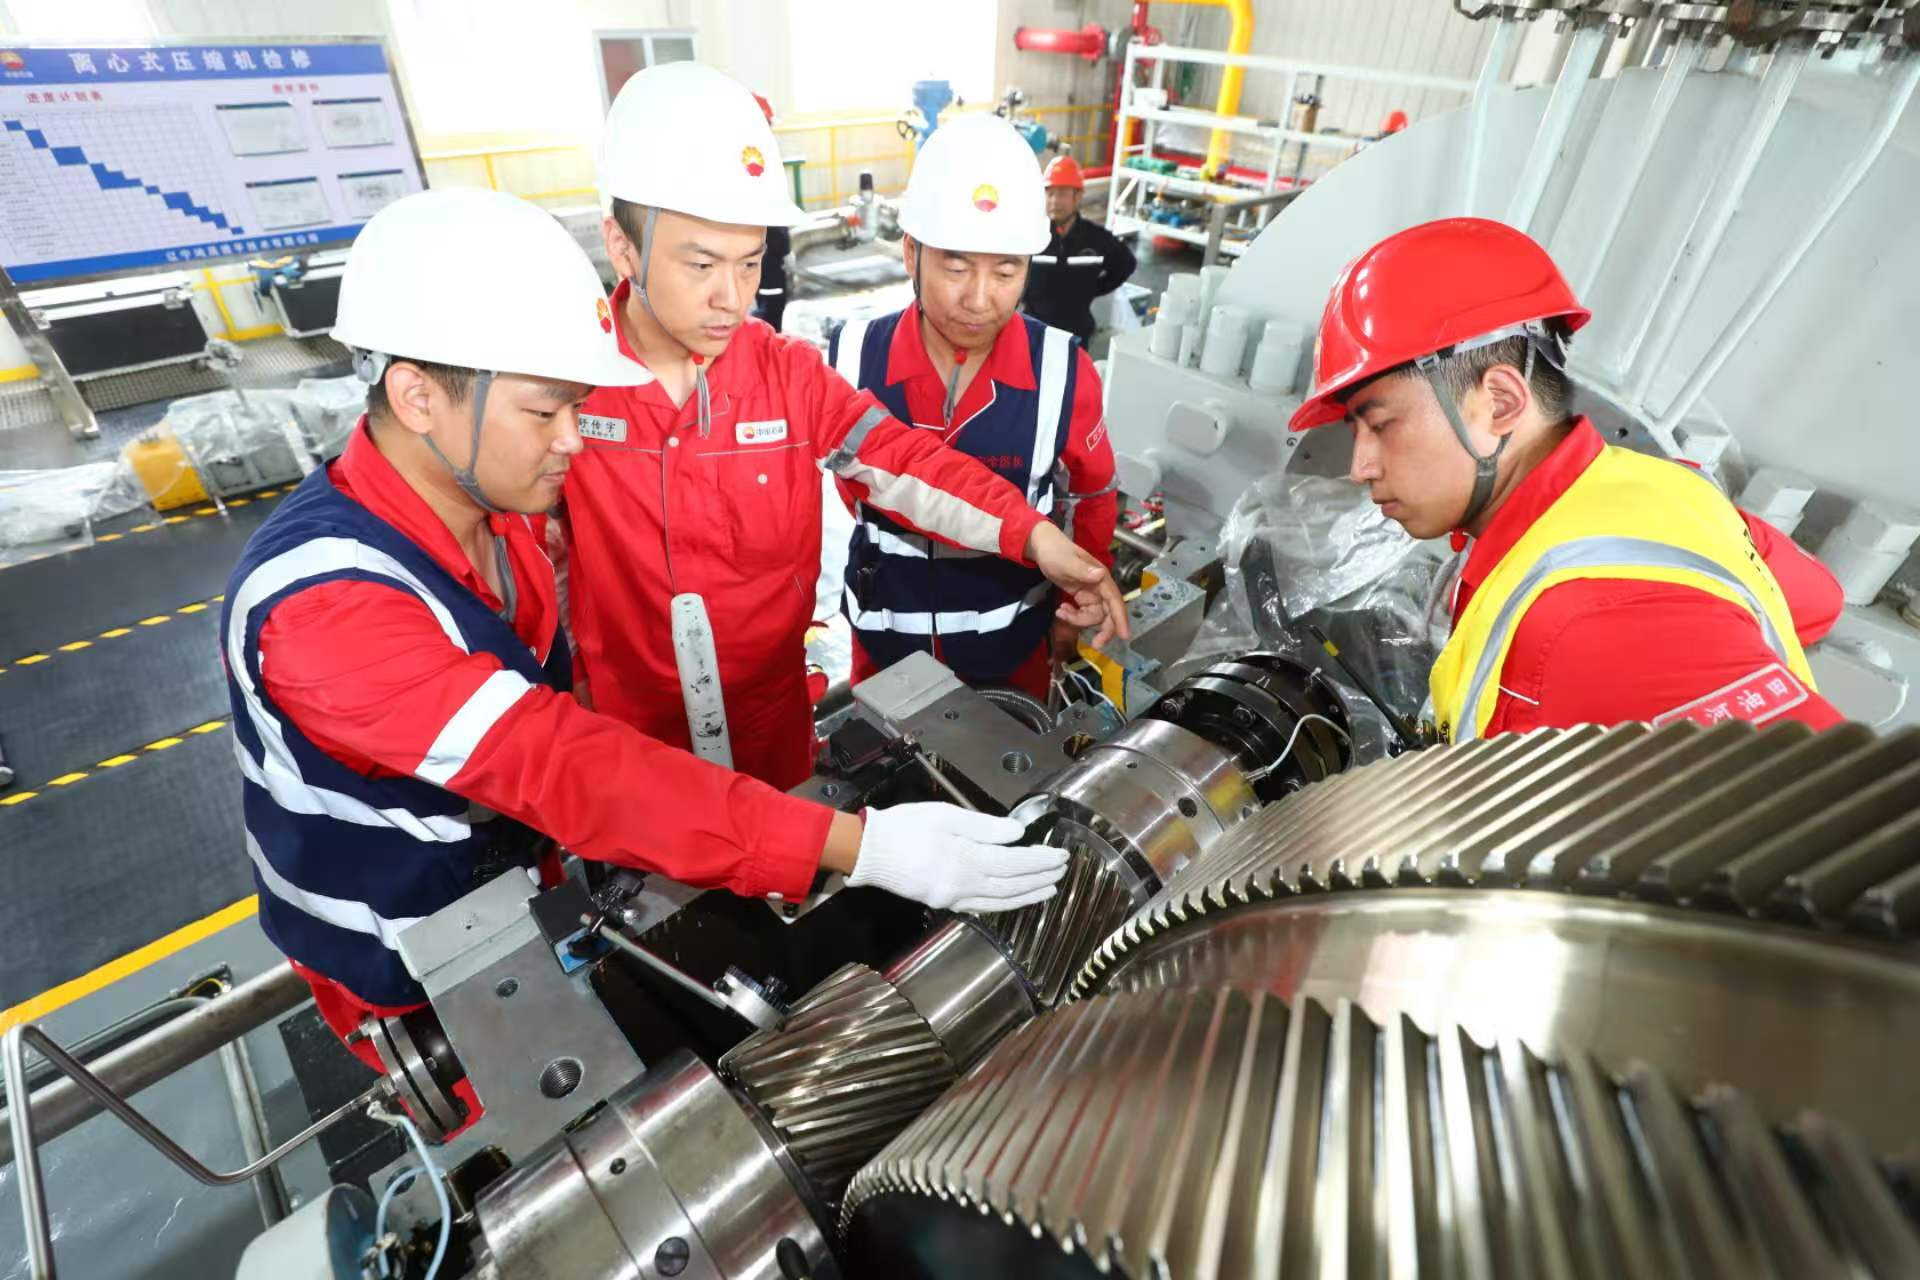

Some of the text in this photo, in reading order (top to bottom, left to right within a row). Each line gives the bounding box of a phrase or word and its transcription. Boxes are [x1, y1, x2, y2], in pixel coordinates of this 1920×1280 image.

[67, 48, 312, 75] 离心式压缩机检修
[1686, 677, 1789, 724] 河油田
